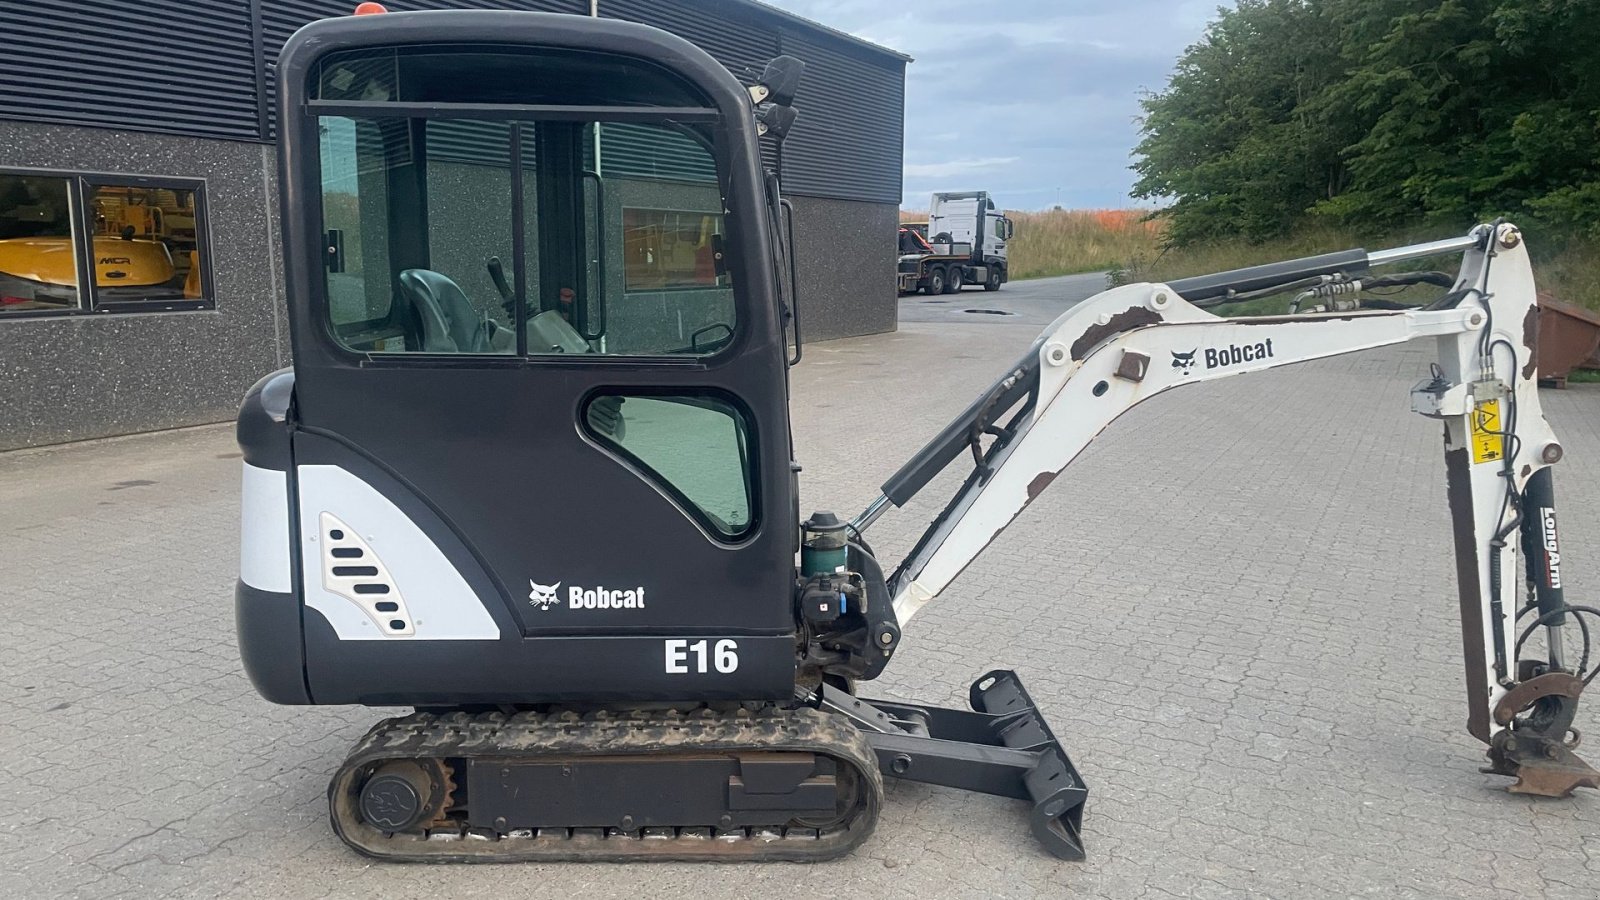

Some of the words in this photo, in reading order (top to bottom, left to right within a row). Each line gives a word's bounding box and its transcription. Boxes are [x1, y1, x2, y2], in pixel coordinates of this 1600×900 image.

[1204, 338, 1274, 369] Bobcat
[1541, 507, 1561, 589] LongArm
[568, 586, 645, 609] Bobcat
[664, 638, 739, 674] E16
